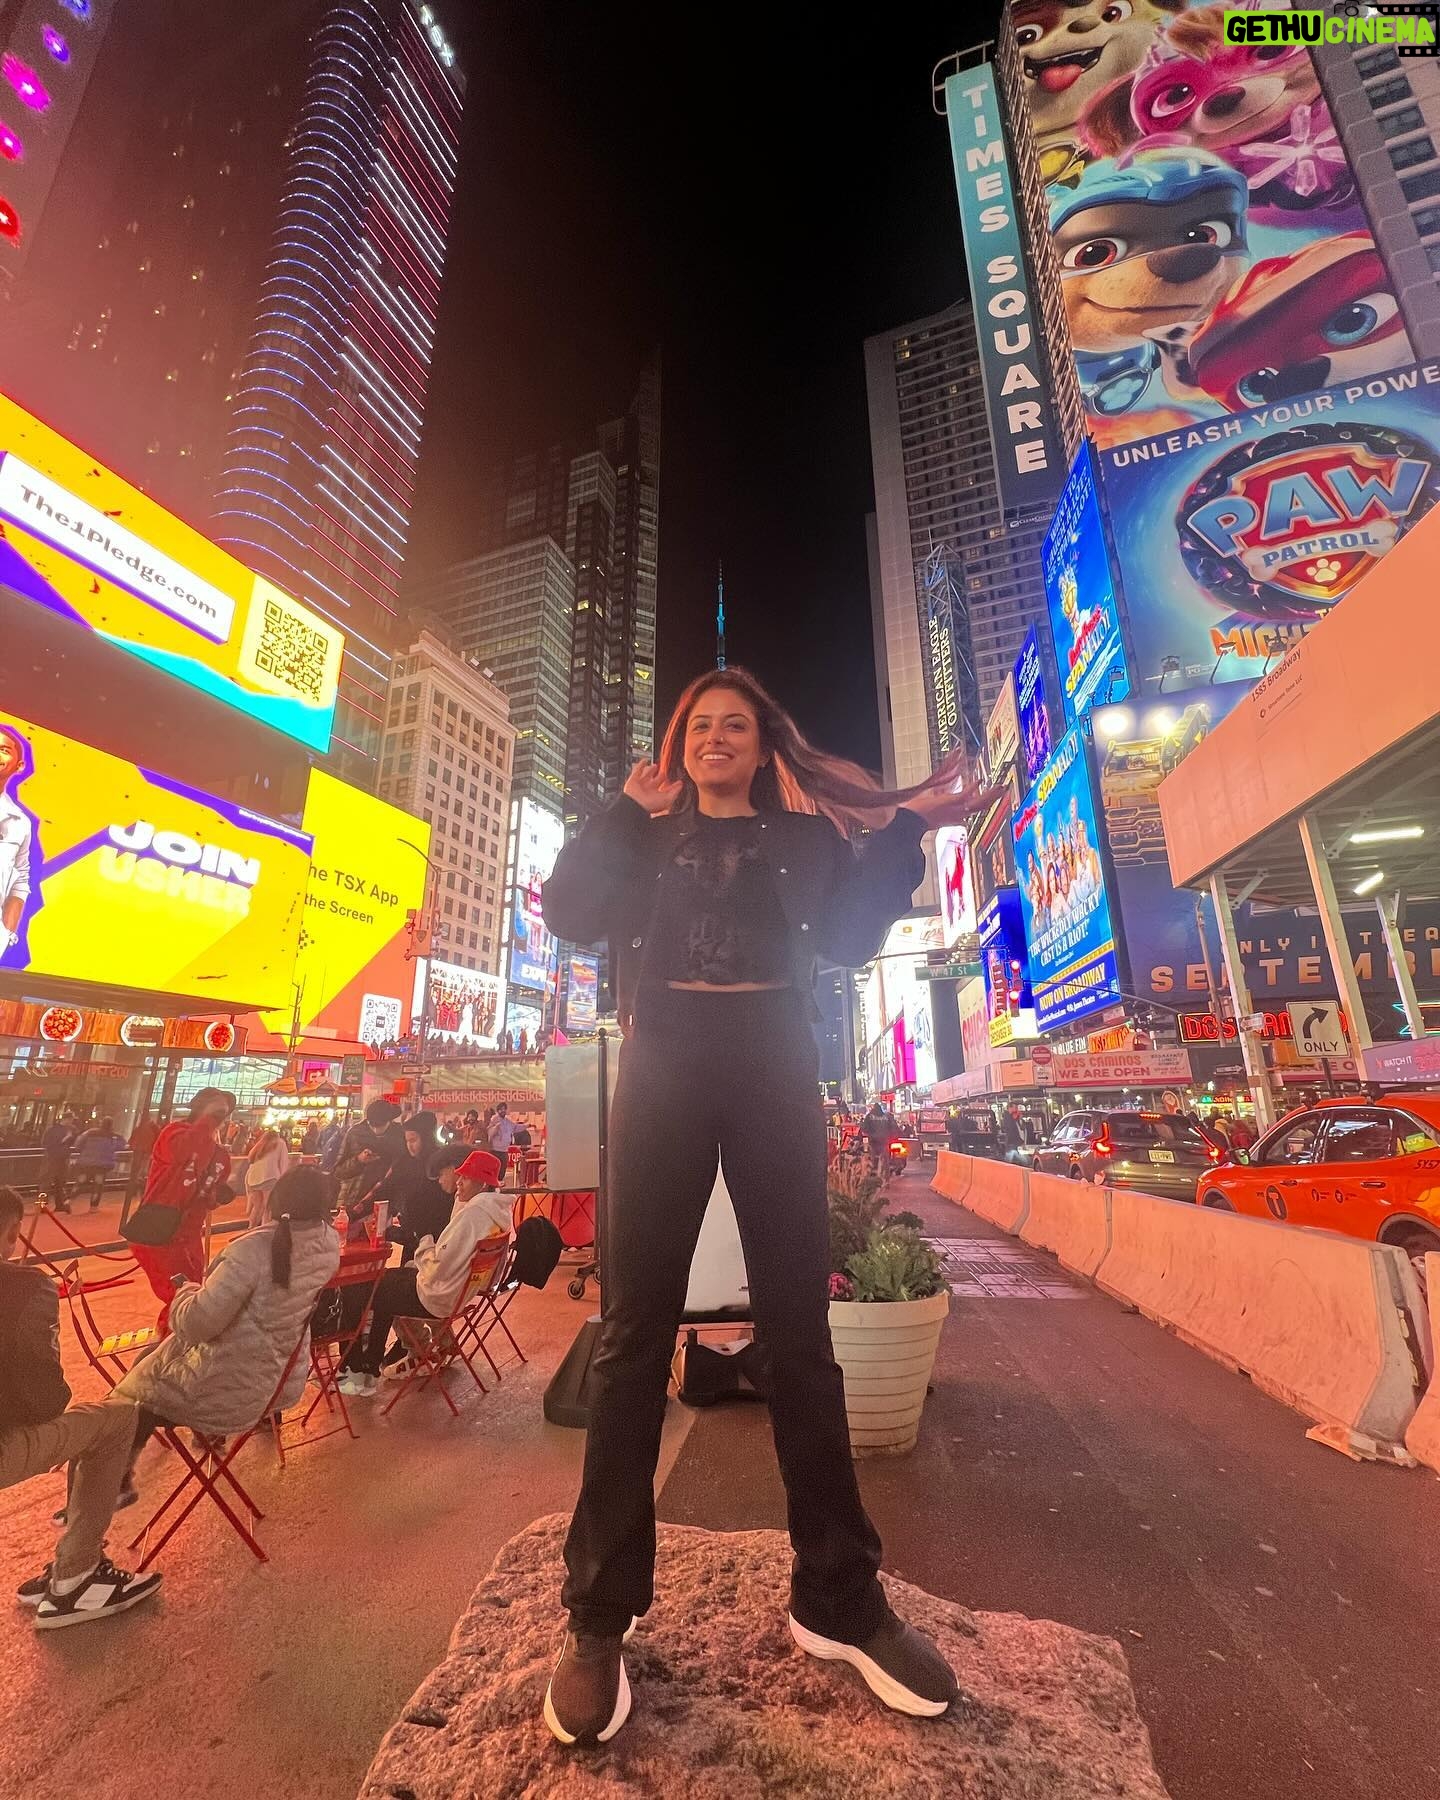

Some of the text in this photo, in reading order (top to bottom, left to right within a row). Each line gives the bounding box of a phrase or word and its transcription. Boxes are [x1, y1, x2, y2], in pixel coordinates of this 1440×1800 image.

[962, 83, 1010, 233] TIMES
[986, 254, 1048, 475] SQUARE
[1112, 419, 1243, 468] UNLEASH
[1251, 393, 1335, 428] YOUR
[1187, 458, 1432, 558] PAW
[20, 484, 218, 619] The1Pledge.com
[1262, 532, 1379, 568] PATROL
[928, 615, 950, 752] AMERICAN EAGLE
[939, 627, 958, 727] OUTFITTERS
[1251, 648, 1301, 702] 1585 Broadway
[108, 820, 261, 886] JOIN
[308, 863, 400, 906] he TSX App
[329, 901, 375, 925] Screen
[1071, 891, 1100, 922] WACKY
[1237, 936, 1291, 955] NLY
[930, 967, 968, 977] W 47 St
[1039, 992, 1055, 1011] NOW
[1053, 987, 1065, 1004] ON
[1064, 962, 1106, 997] BROADWAY
[1064, 1055, 1142, 1068] DOS CAMINOS
[1075, 1036, 1087, 1051] FIN
[1304, 1041, 1338, 1053] ONLY
[1384, 1057, 1405, 1067] WATCH
[1406, 1055, 1412, 1065] IT
[1058, 1069, 1080, 1079] WE
[1083, 1068, 1110, 1078] ARE
[1114, 1067, 1151, 1077] OPEN
